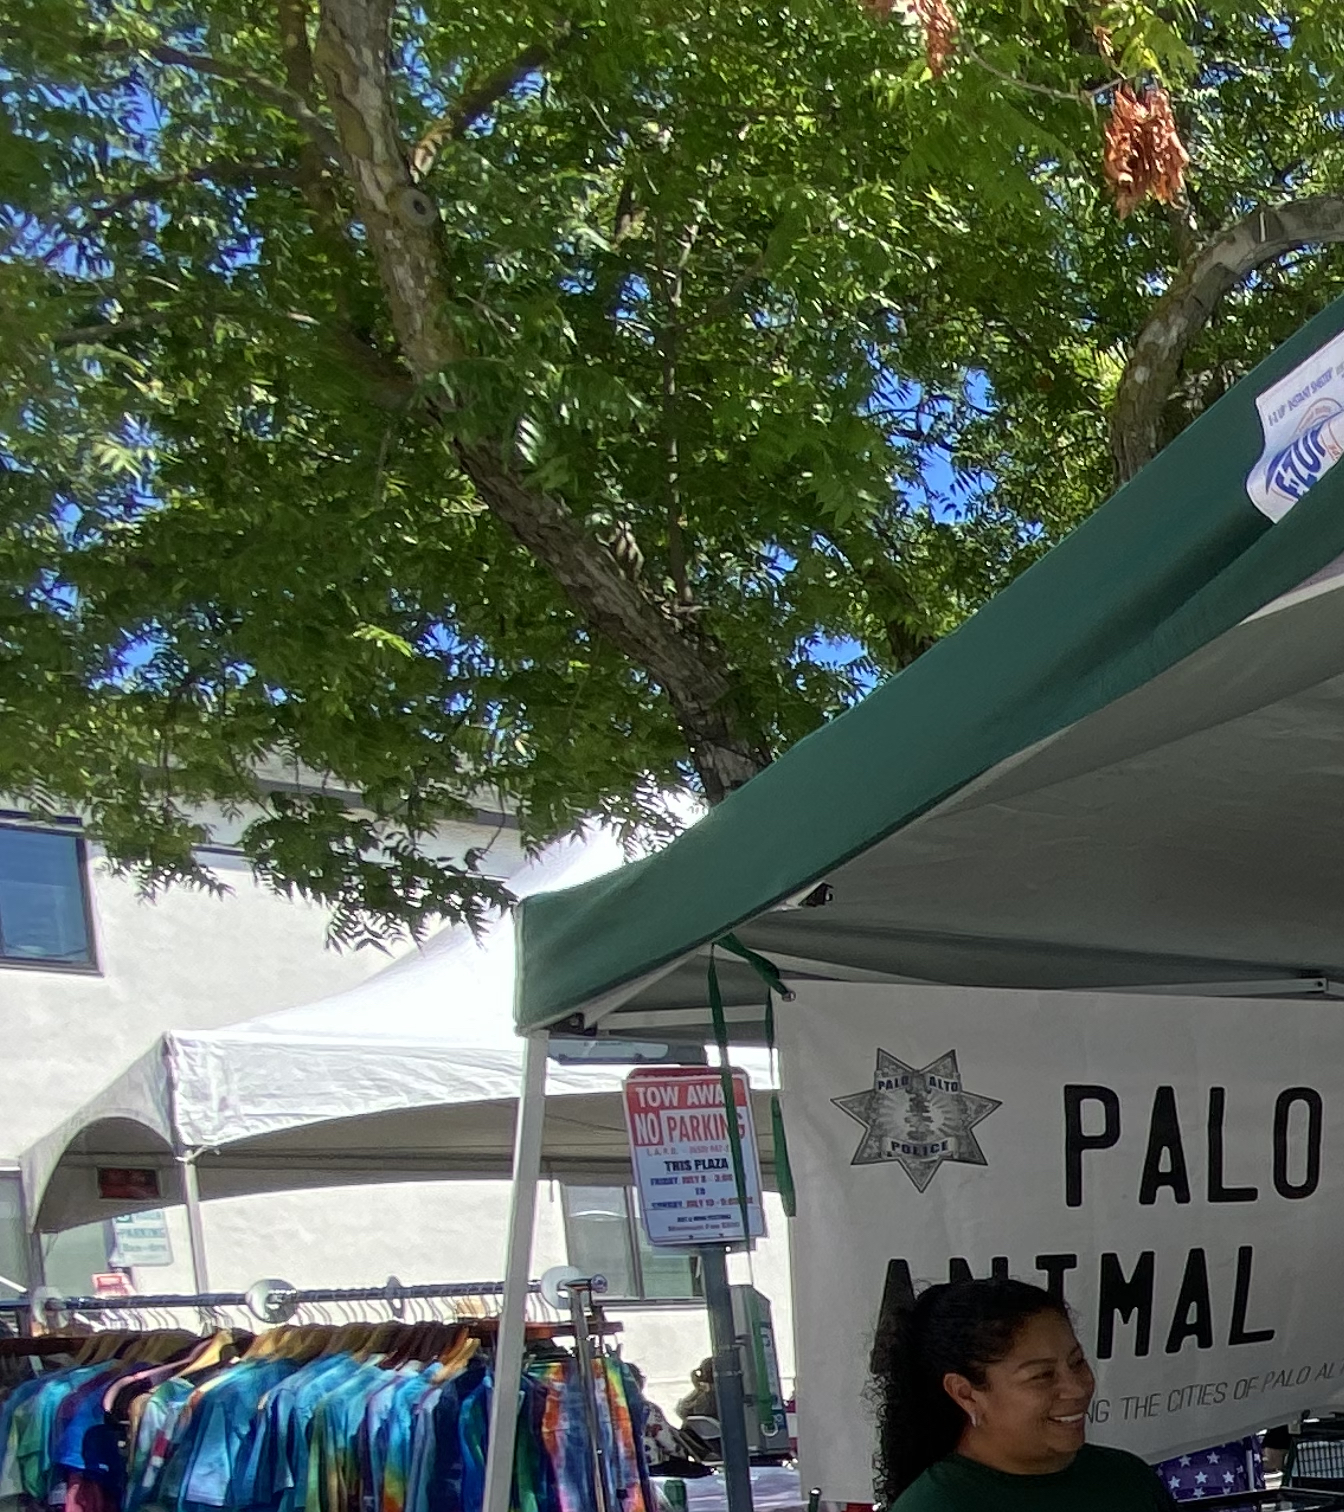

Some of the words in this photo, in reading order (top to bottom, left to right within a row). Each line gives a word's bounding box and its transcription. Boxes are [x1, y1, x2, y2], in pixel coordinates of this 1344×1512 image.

[878, 1075, 909, 1091] PALO
[929, 1076, 959, 1092] ALTO
[635, 1086, 678, 1107] TOW
[687, 1085, 726, 1106] AWA
[635, 1113, 661, 1145] NO
[891, 1139, 949, 1156] POLICE
[1064, 1083, 1323, 1207] PALO
[664, 1160, 691, 1172] THIS
[694, 1158, 728, 1170] PLAZA
[1121, 1393, 1160, 1420] THE
[1168, 1382, 1228, 1413] CITIES
[1233, 1376, 1259, 1401] OF
[1261, 1366, 1311, 1393] PALO
